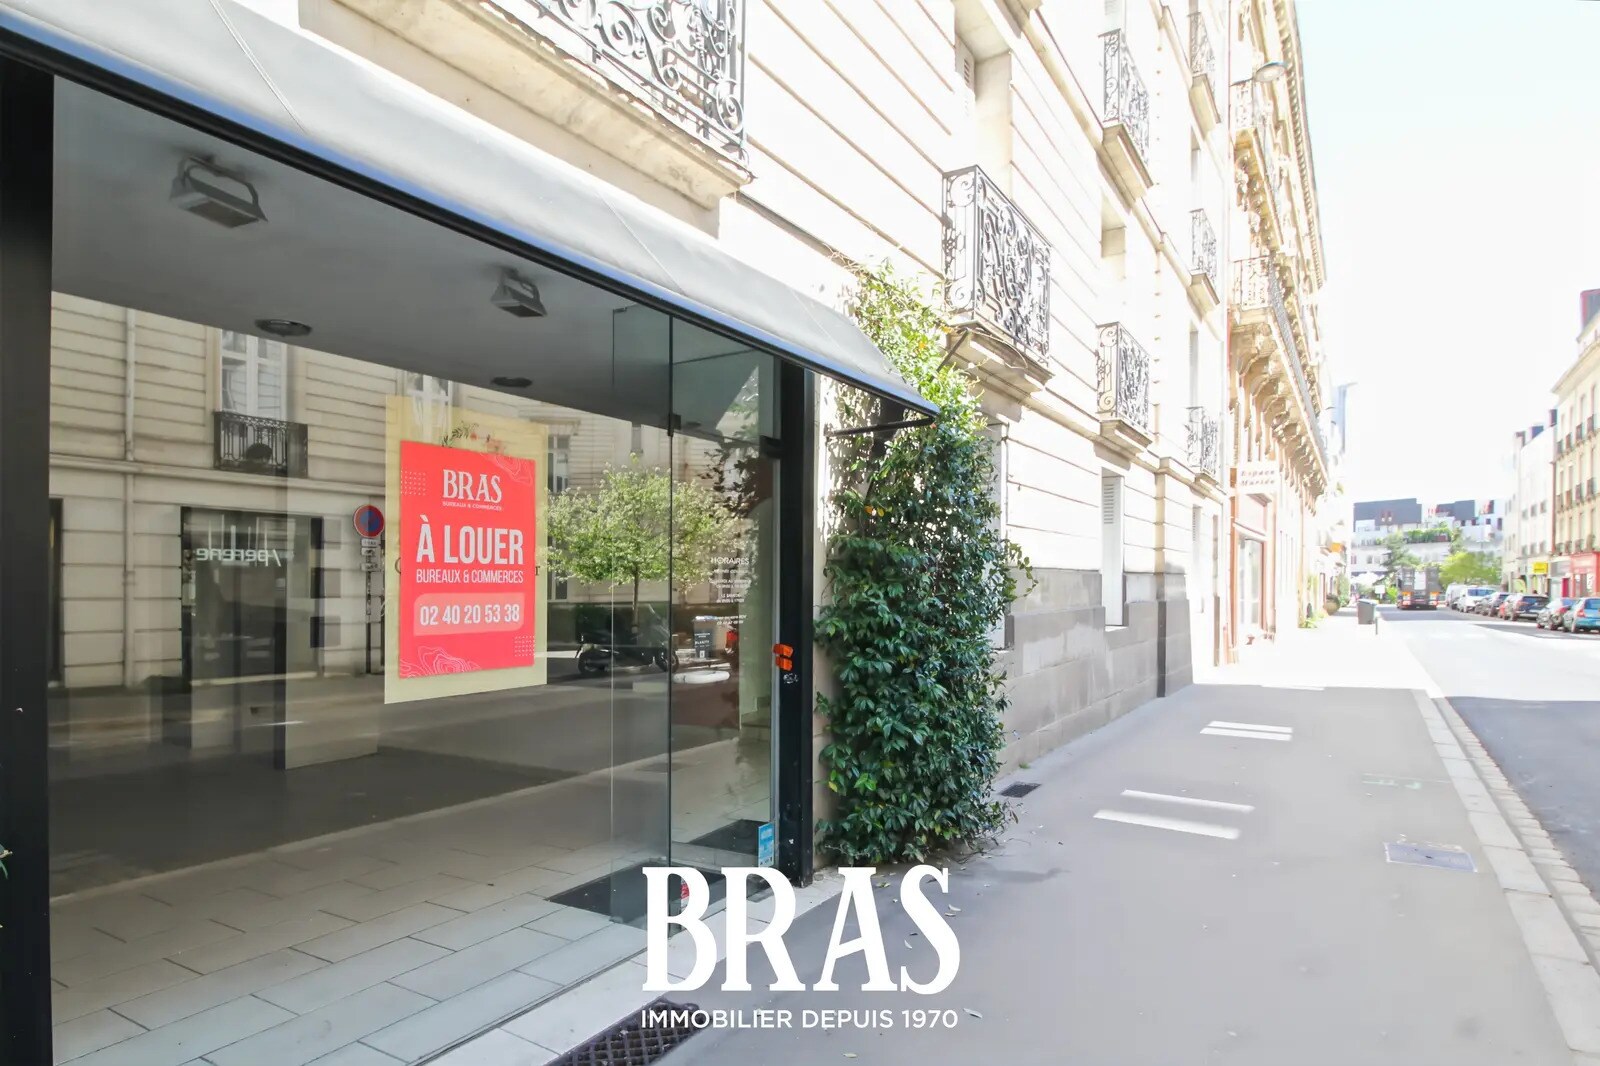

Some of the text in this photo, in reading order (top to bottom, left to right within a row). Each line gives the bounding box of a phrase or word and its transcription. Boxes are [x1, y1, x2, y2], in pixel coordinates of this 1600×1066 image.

[442, 469, 502, 503] BRAS
[416, 514, 524, 565] À LOUER
[416, 569, 460, 583] BUREAUX
[463, 569, 469, 583] &
[471, 570, 524, 583] COMMERCES
[420, 603, 520, 626] 02 40 20 53 38
